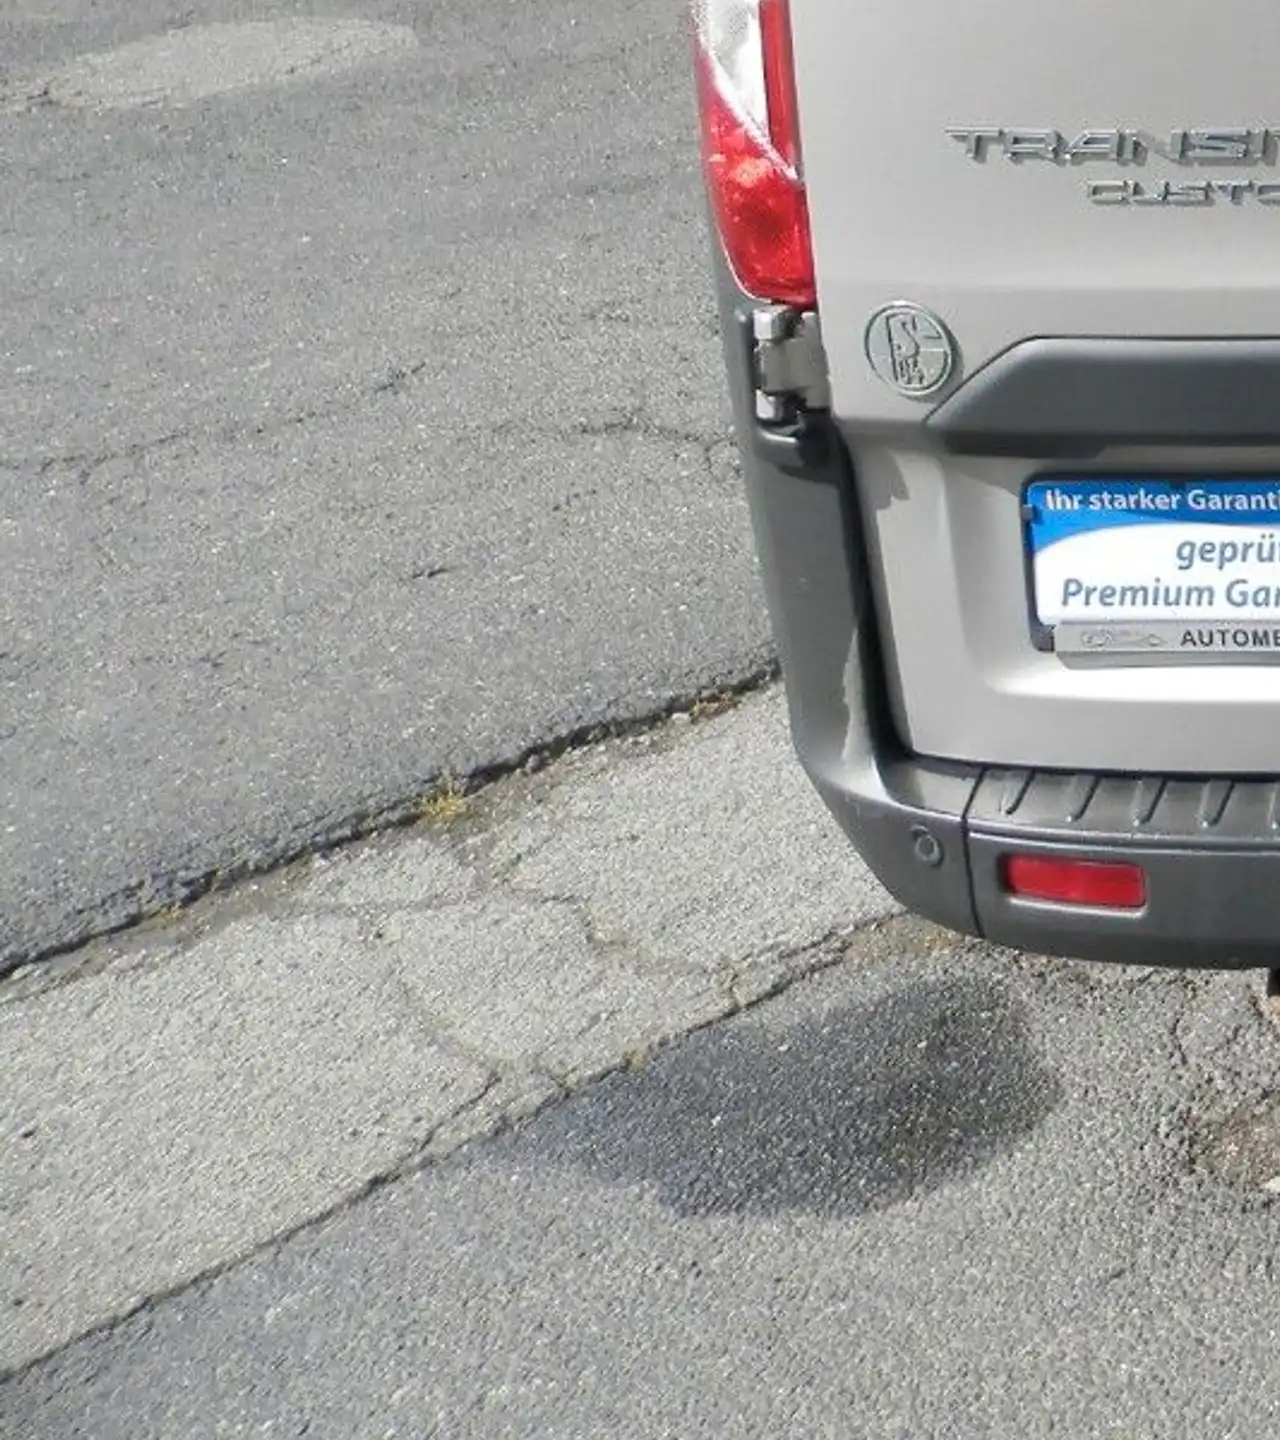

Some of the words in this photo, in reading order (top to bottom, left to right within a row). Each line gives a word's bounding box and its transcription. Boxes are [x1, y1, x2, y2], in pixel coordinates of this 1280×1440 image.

[1045, 488, 1082, 511] Ihr
[1089, 488, 1180, 511] starker
[1060, 577, 1214, 608] Premium
